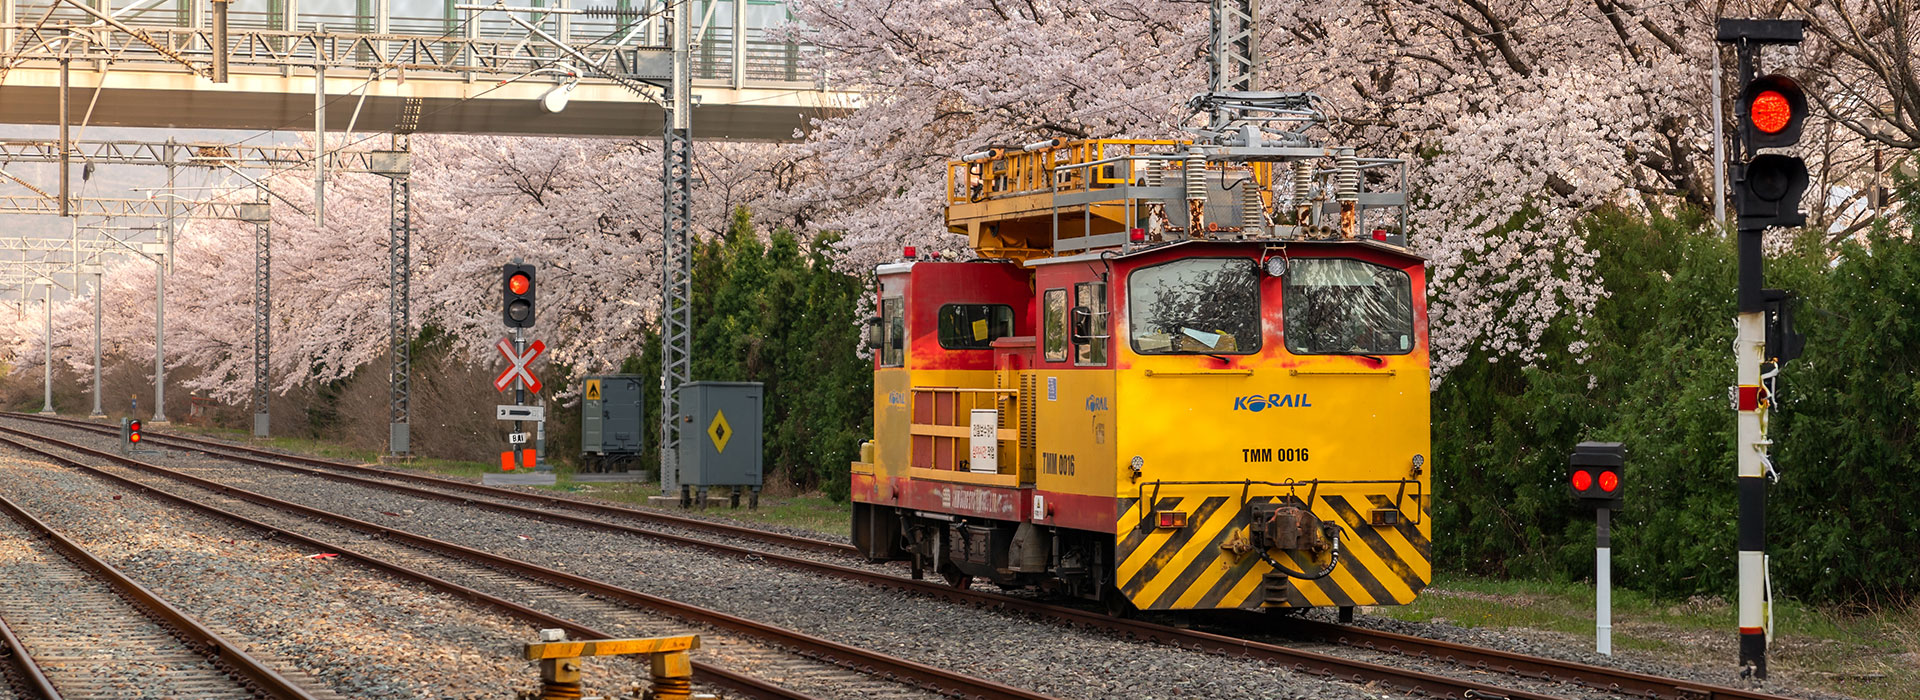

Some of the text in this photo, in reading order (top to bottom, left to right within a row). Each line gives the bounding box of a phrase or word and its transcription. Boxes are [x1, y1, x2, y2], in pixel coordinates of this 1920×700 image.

[1085, 394, 1109, 412] KORAIL
[1233, 393, 1312, 412] KORAIL
[1242, 448, 1309, 462] TMM 0016
[1042, 452, 1075, 477] TMM 0016
